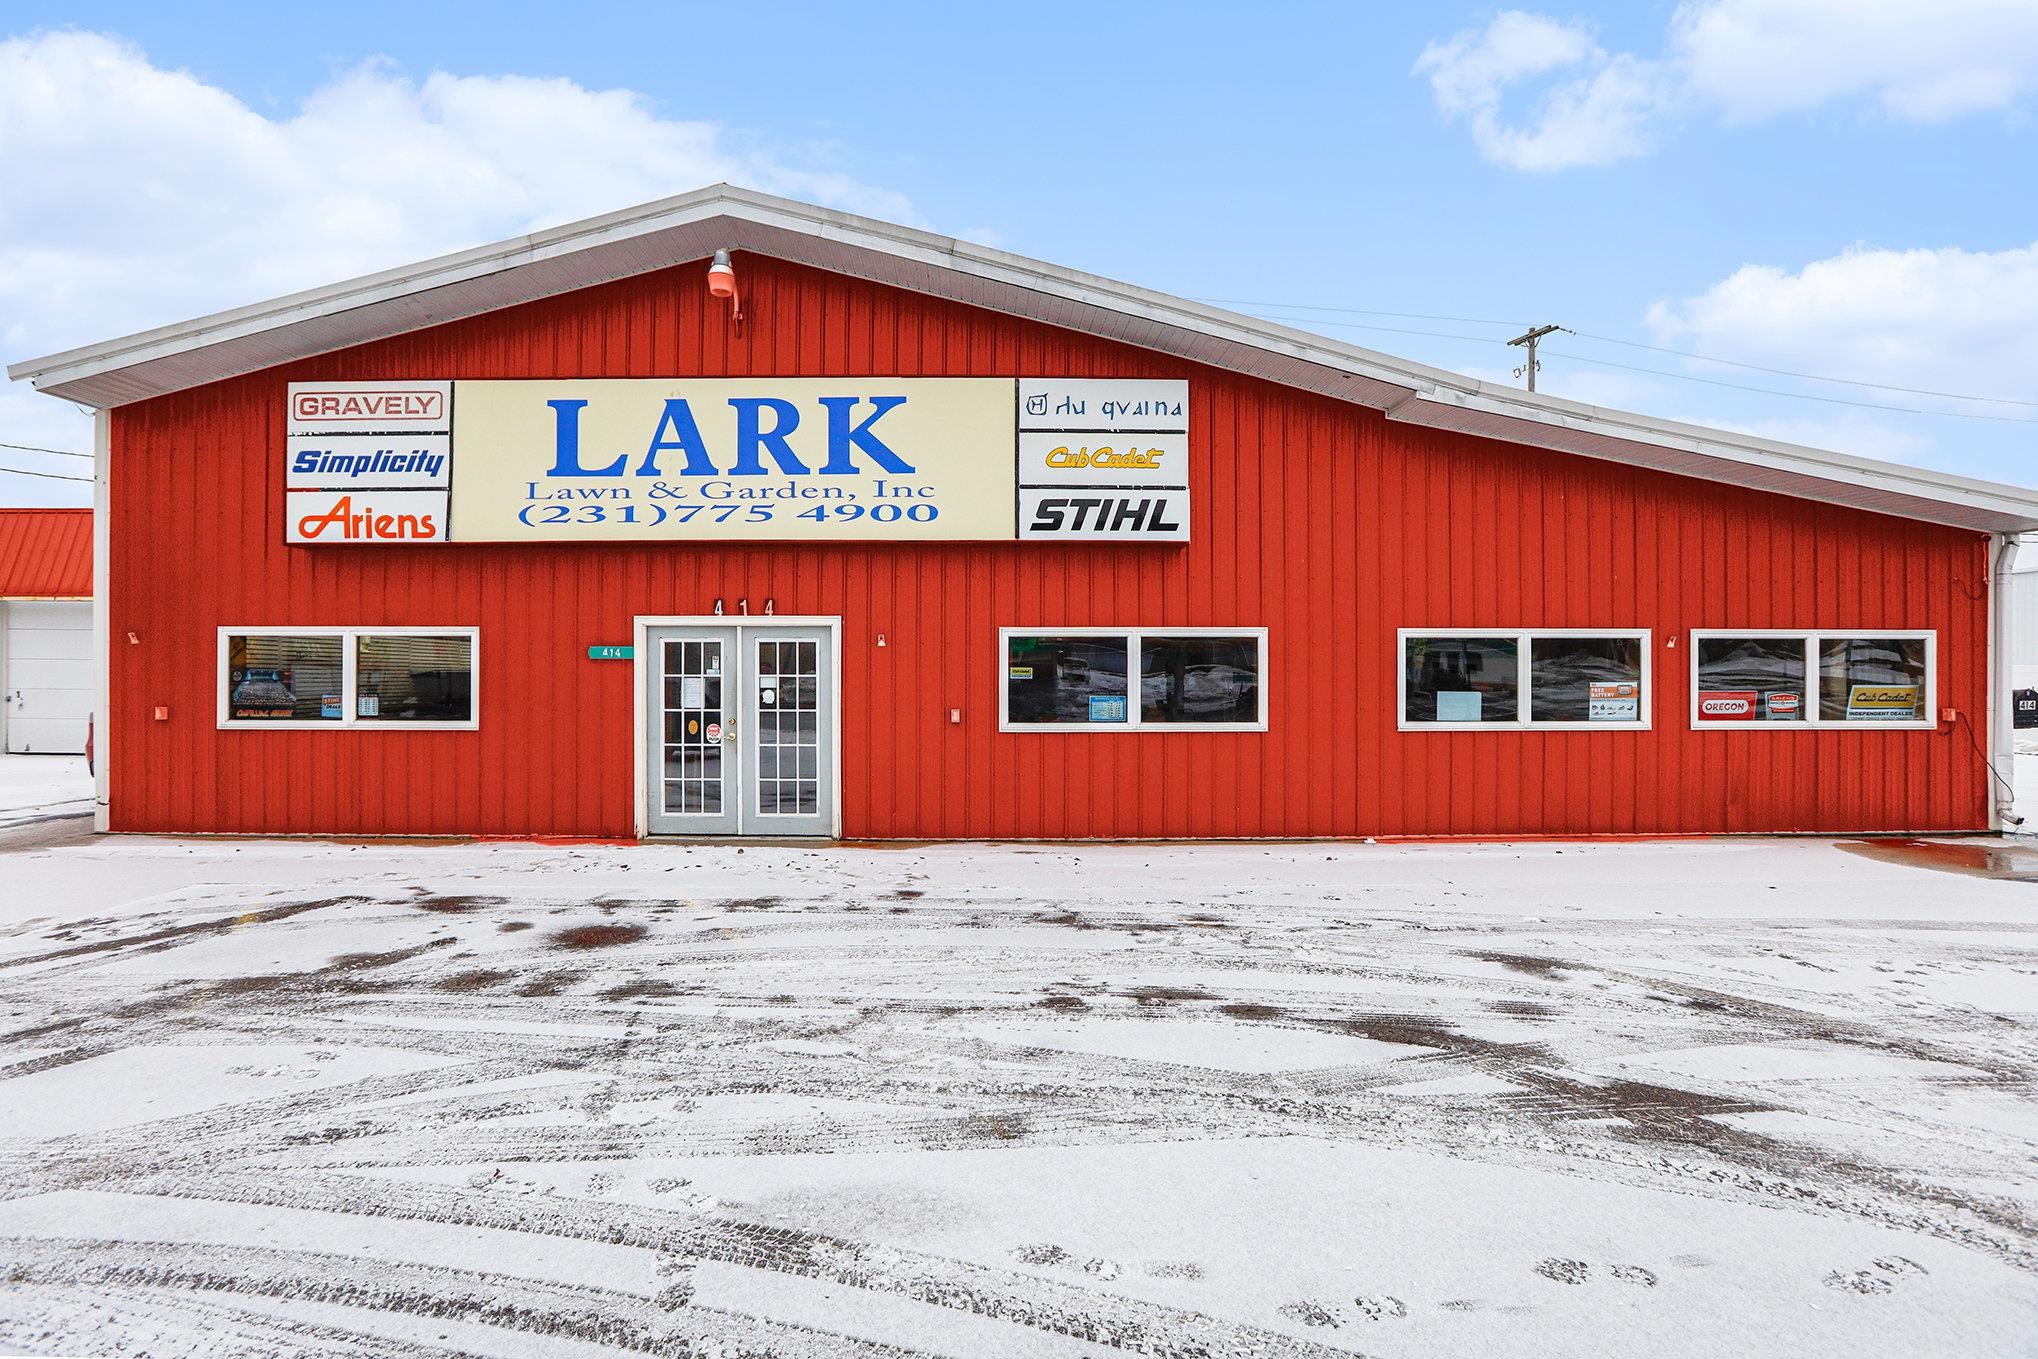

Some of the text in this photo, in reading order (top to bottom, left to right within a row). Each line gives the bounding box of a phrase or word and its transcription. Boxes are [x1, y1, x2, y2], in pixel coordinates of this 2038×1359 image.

[299, 394, 434, 417] GRAVELY
[545, 395, 916, 479] LARK
[292, 449, 445, 478] Simplicity
[1045, 446, 1165, 469] Cub Cadet
[525, 479, 936, 502] Lawn & Garden, Inc
[298, 495, 437, 540] Ariens
[517, 503, 940, 528] (231)775 4900
[1029, 498, 1180, 532] STIHL
[602, 647, 621, 658] 414
[1705, 703, 1745, 711] OREGON
[1856, 692, 1912, 702] Cub Cadet
